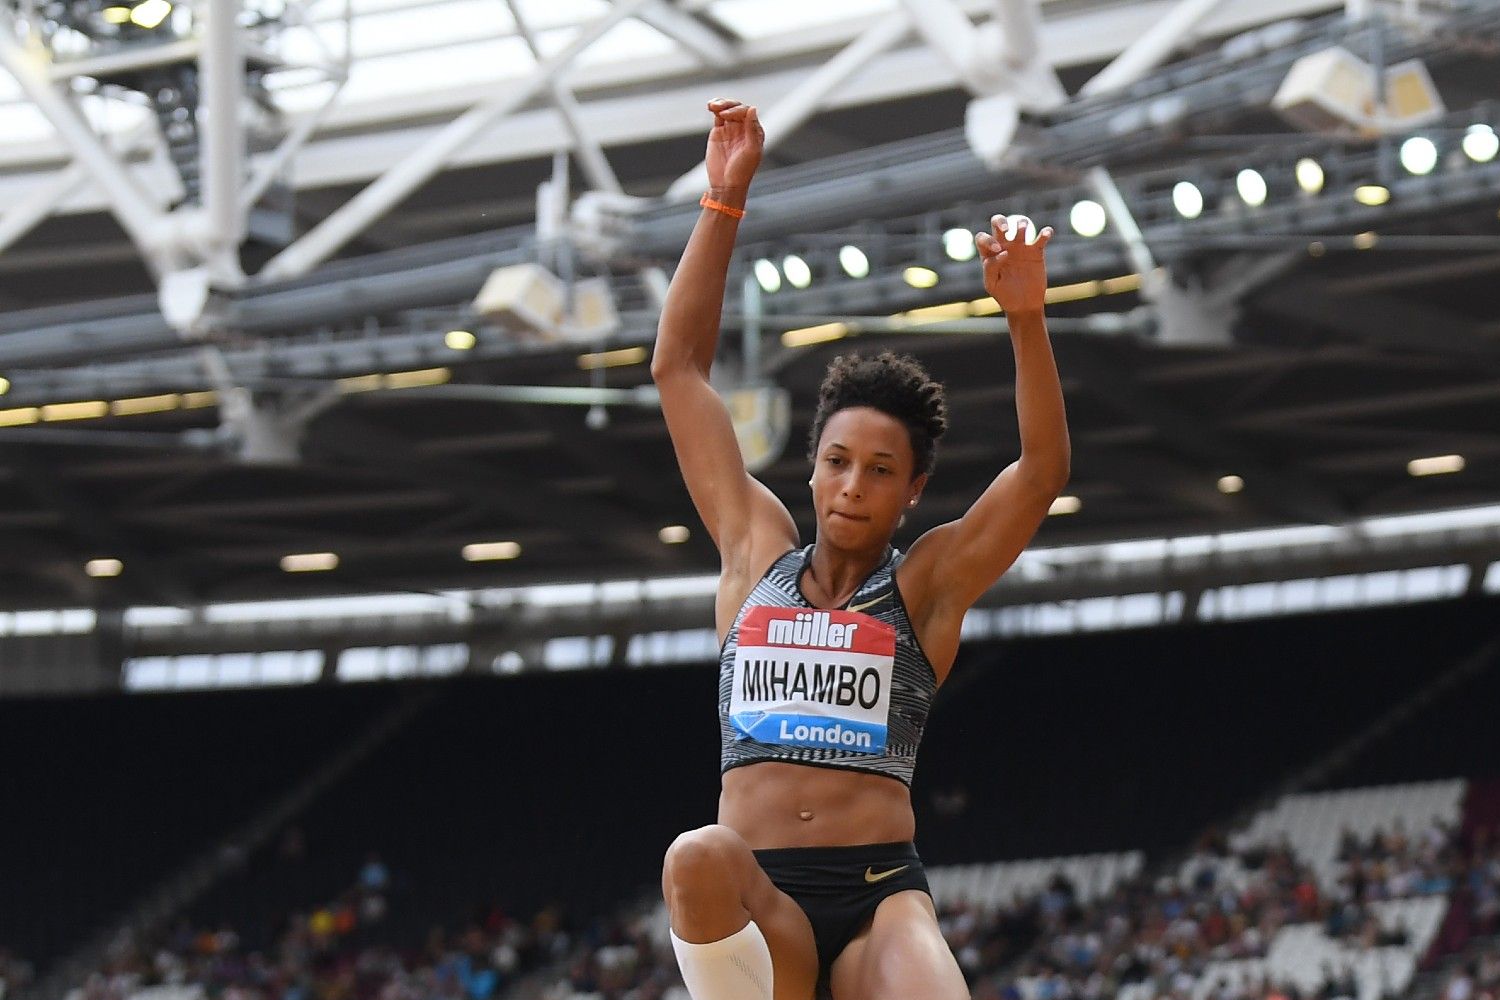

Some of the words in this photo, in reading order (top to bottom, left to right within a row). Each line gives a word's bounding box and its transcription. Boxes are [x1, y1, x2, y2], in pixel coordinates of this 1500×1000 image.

[767, 612, 858, 649] müller
[742, 659, 881, 710] MIHAMBO
[779, 719, 871, 748] London
